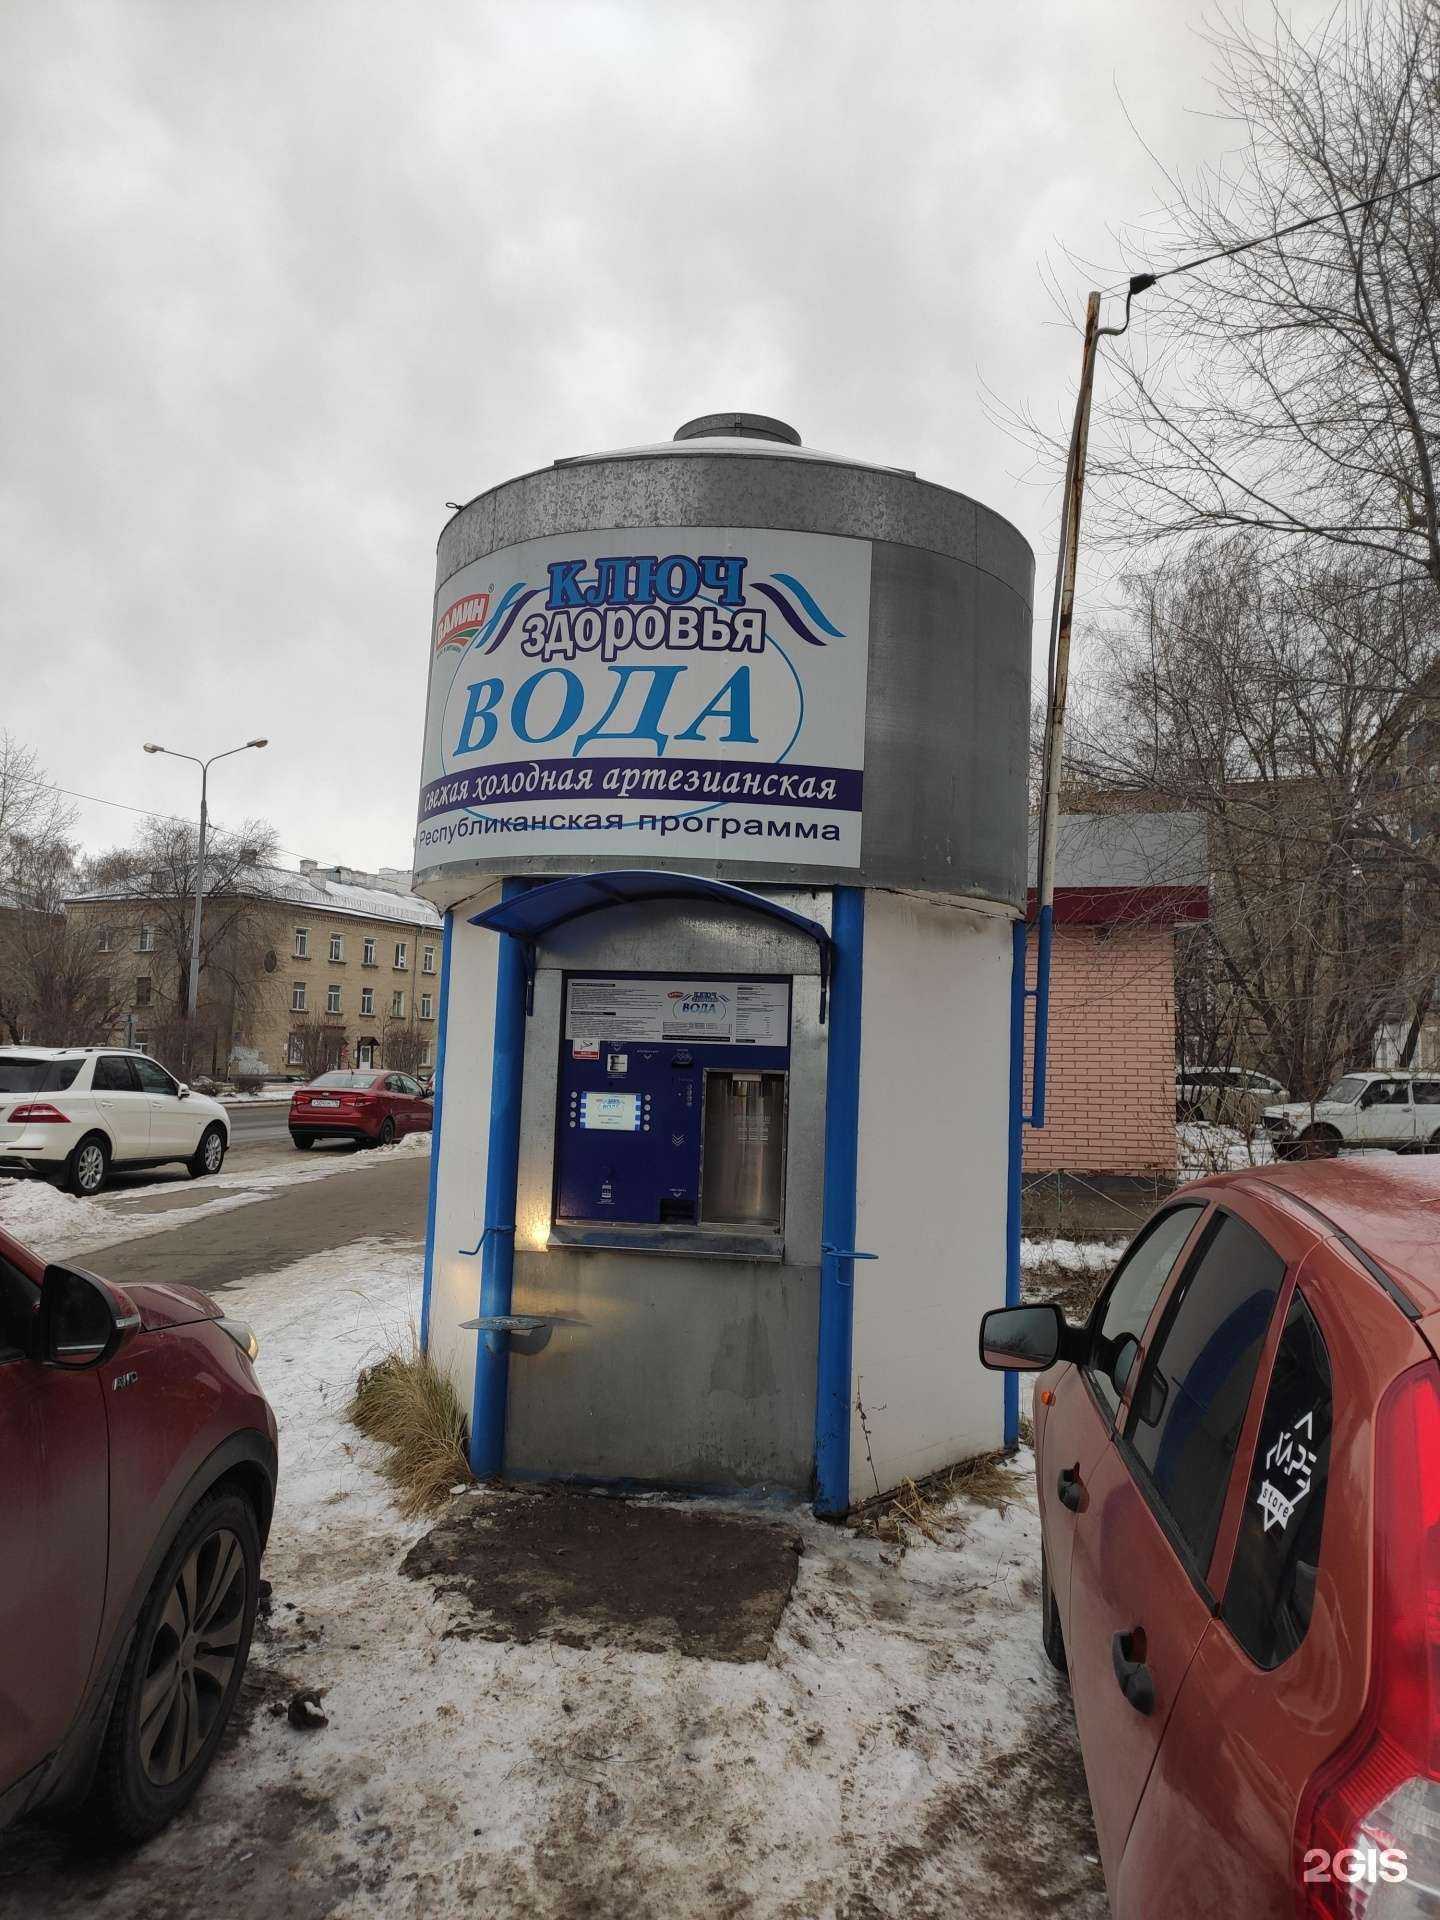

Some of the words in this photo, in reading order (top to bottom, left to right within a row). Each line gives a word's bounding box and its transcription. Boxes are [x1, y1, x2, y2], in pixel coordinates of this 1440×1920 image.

[453, 665, 759, 757] ВОДА
[424, 779, 469, 812] свежая
[473, 763, 593, 801] холодная
[602, 766, 837, 801] артезианская
[419, 813, 624, 849] Республиканская
[638, 814, 841, 841] программа
[1262, 1487, 1290, 1518] store
